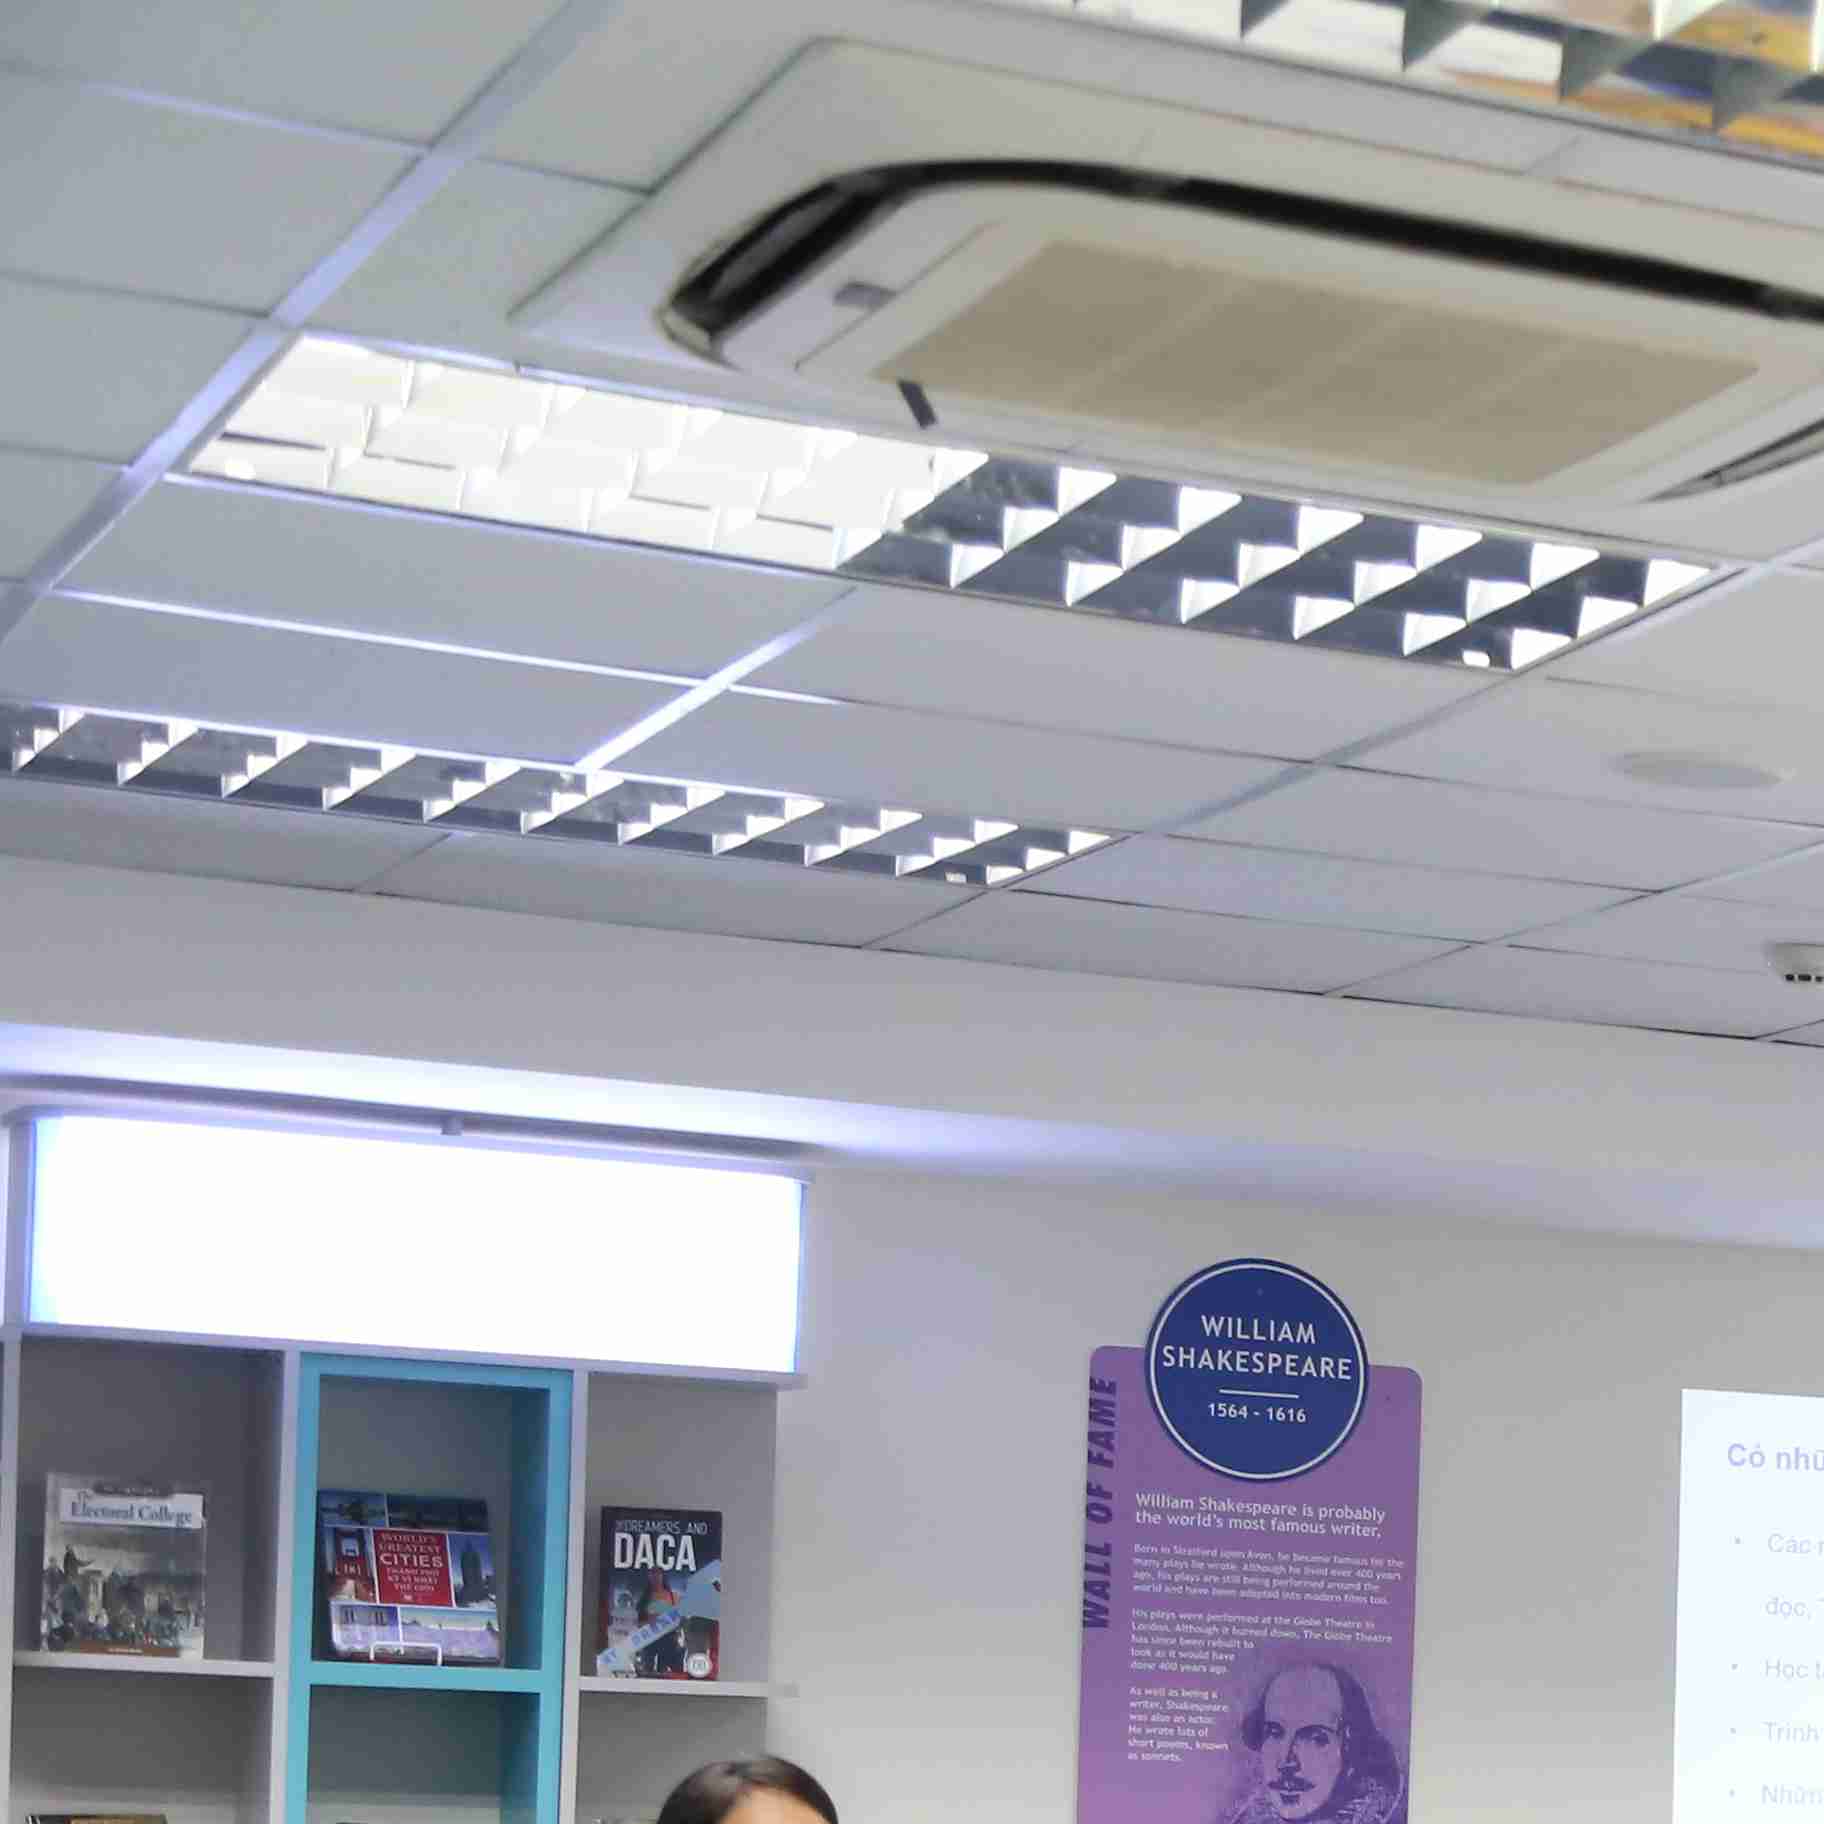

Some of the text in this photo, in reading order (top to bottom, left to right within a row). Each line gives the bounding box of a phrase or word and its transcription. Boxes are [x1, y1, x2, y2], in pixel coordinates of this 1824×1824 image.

[1201, 1315, 1317, 1344] WILLIAM
[1162, 1345, 1352, 1380] SHAKESPEARE
[1207, 1402, 1248, 1419] 1564
[1266, 1406, 1307, 1423] 1616
[1726, 1442, 1766, 1468] Có
[138, 1505, 192, 1526] College
[1083, 1377, 1117, 1629] WALL OF FAME
[1136, 1493, 1385, 1524] William Shakespeare is probably
[624, 1520, 708, 1535] DREAMERS AND
[1135, 1510, 1160, 1525] the
[1167, 1511, 1223, 1528] world's
[1229, 1515, 1265, 1531] most
[1271, 1517, 1326, 1535] famous
[615, 1533, 696, 1571] DACA
[1768, 1532, 1812, 1556] Các
[380, 1553, 443, 1568] CITIES
